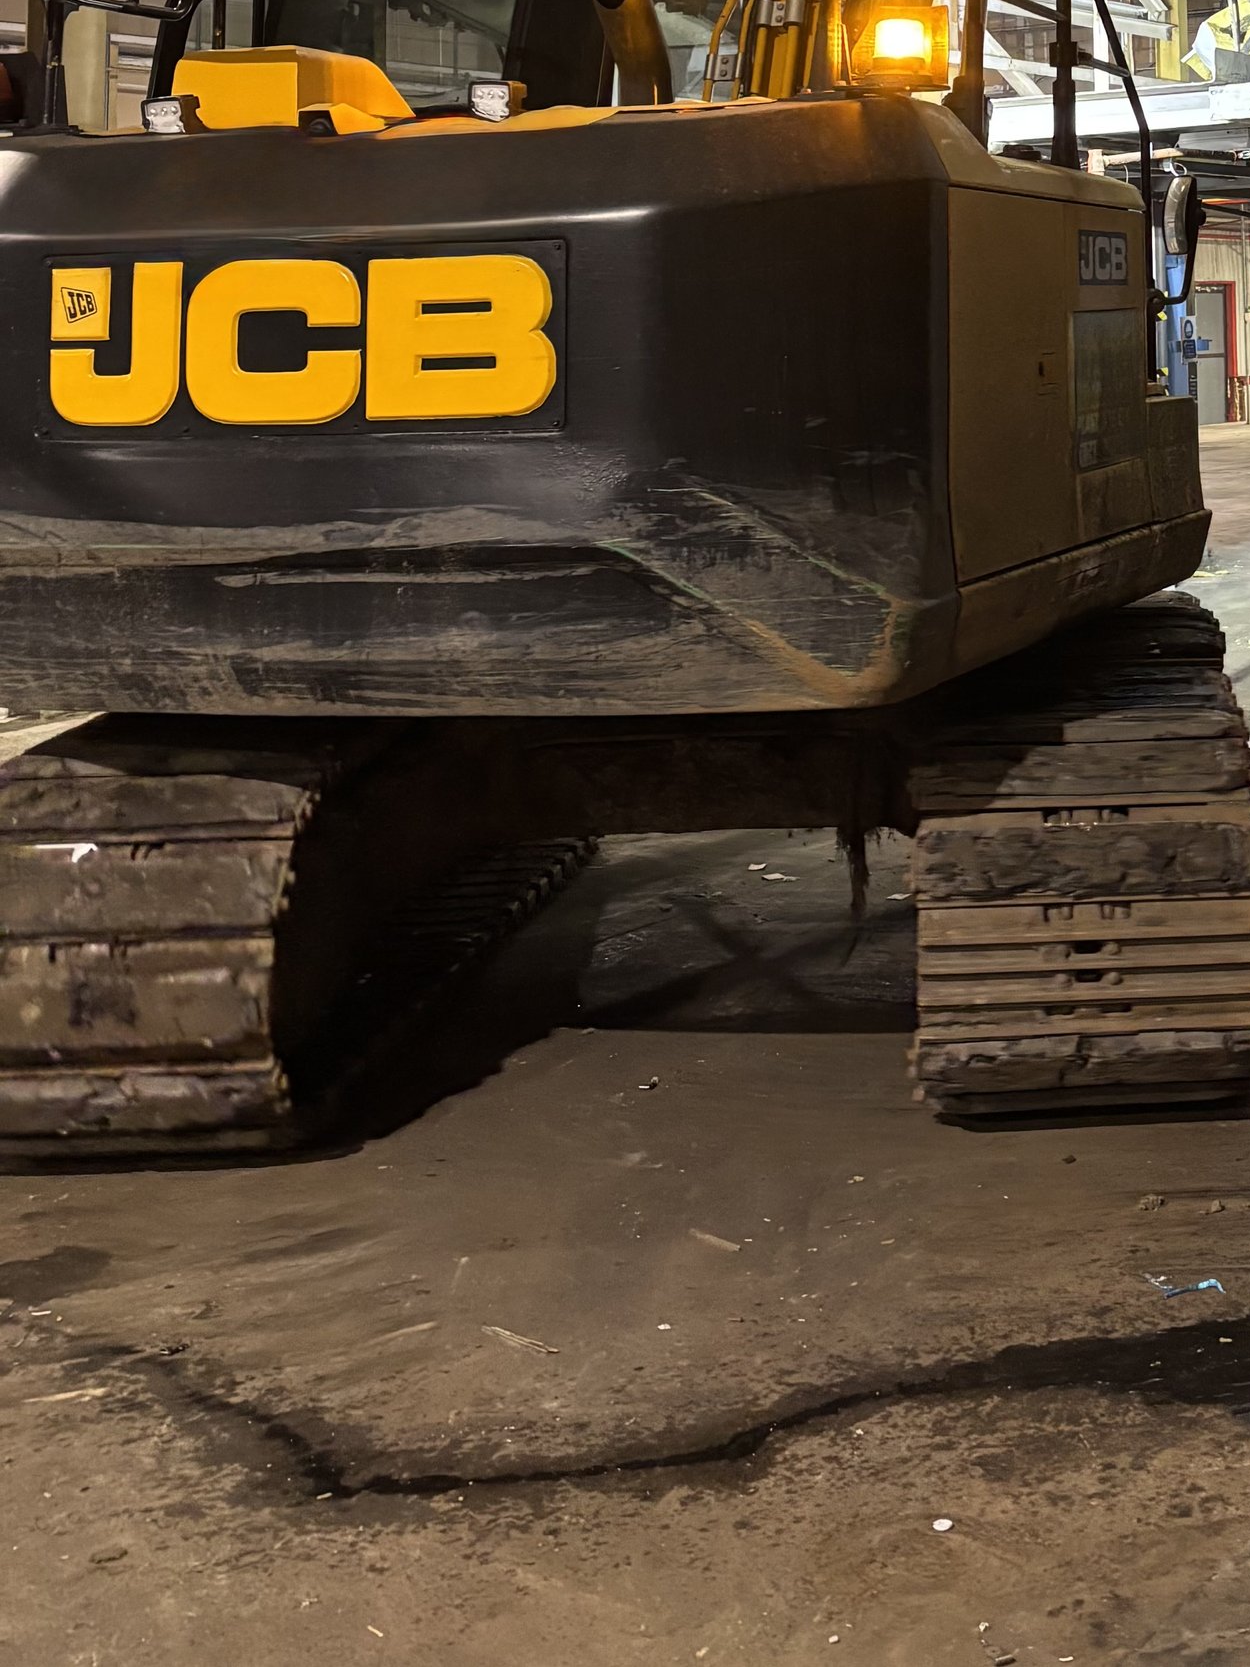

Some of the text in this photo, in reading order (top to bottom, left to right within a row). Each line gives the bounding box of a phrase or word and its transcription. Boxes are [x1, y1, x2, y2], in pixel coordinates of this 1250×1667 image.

[1080, 235, 1127, 281] JCB
[67, 291, 95, 319] JCB
[49, 254, 558, 426] JCB
